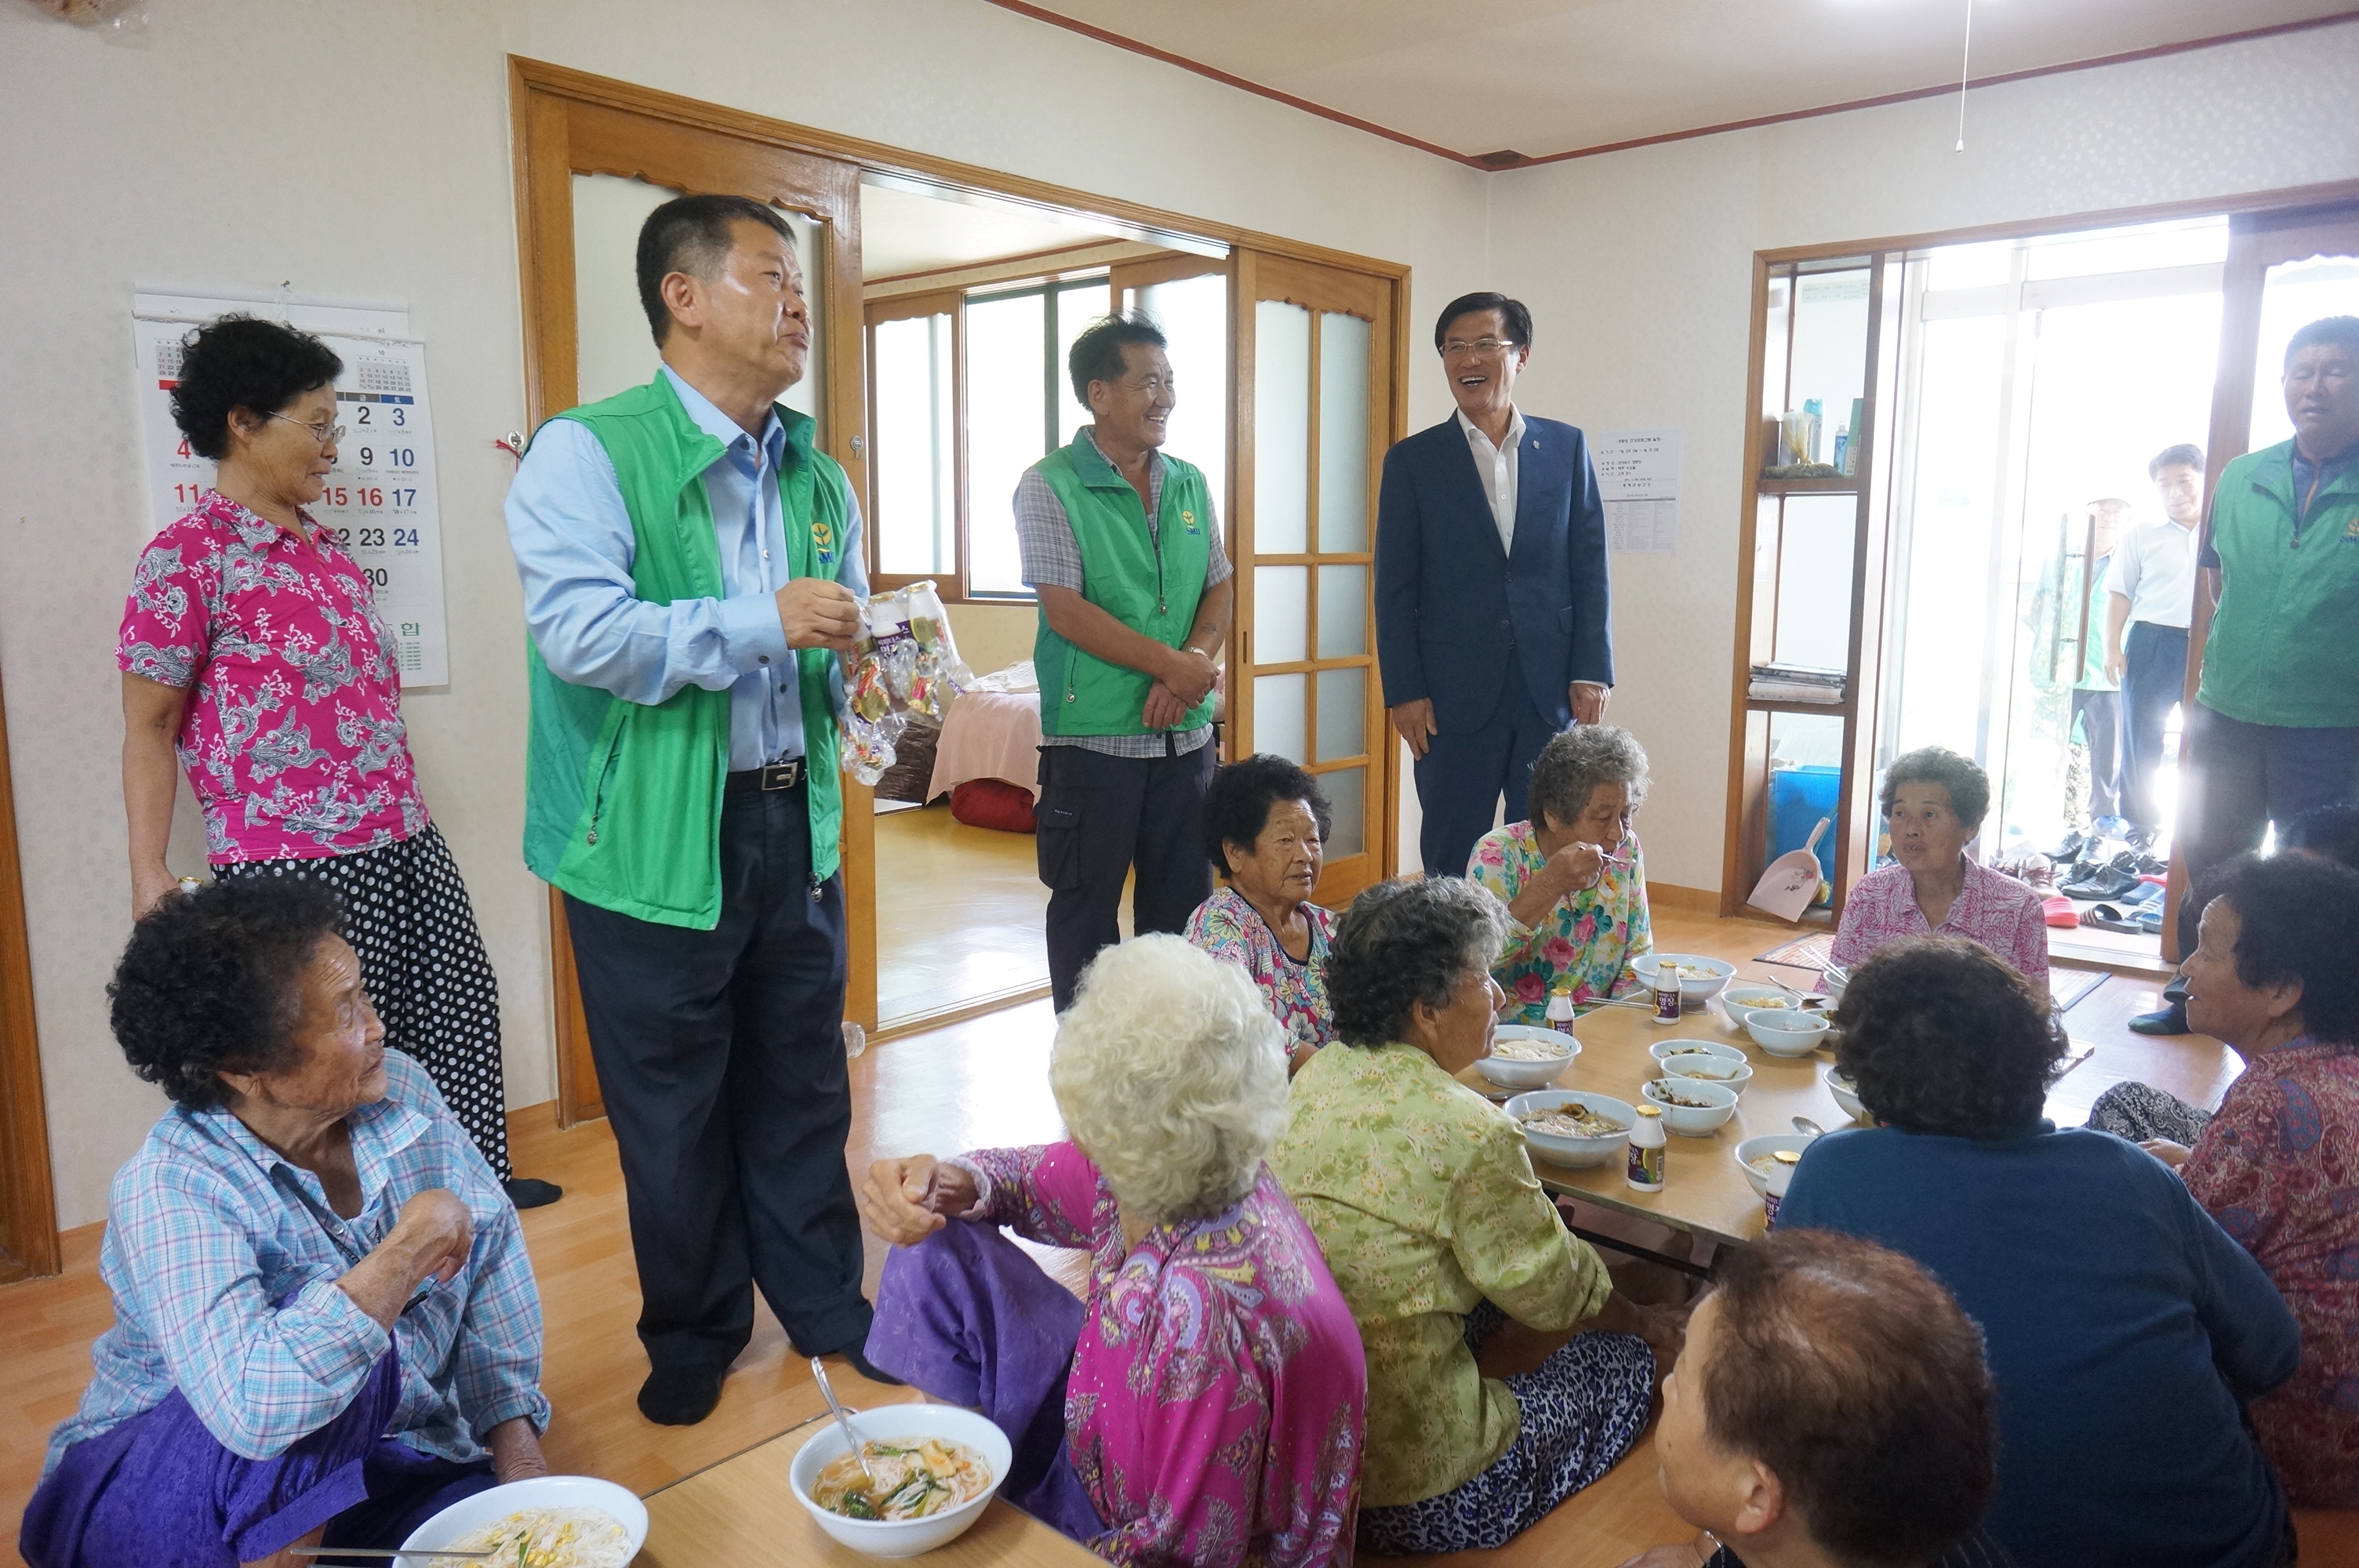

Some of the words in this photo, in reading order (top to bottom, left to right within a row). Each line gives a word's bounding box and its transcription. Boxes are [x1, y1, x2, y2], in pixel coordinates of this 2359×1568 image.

[358, 406, 371, 425] 2
[393, 408, 405, 426] 3
[177, 438, 191, 459] 4
[360, 447, 373, 466] 9
[390, 448, 414, 466] 10
[174, 484, 199, 503] 11
[322, 487, 347, 506] 15
[357, 488, 383, 506] 16
[392, 488, 416, 506] 17
[359, 528, 385, 546] 23
[394, 528, 420, 546] 24
[362, 568, 388, 586] 30
[878, 635, 901, 646] 비피더스
[1659, 996, 1675, 1007] 명장
